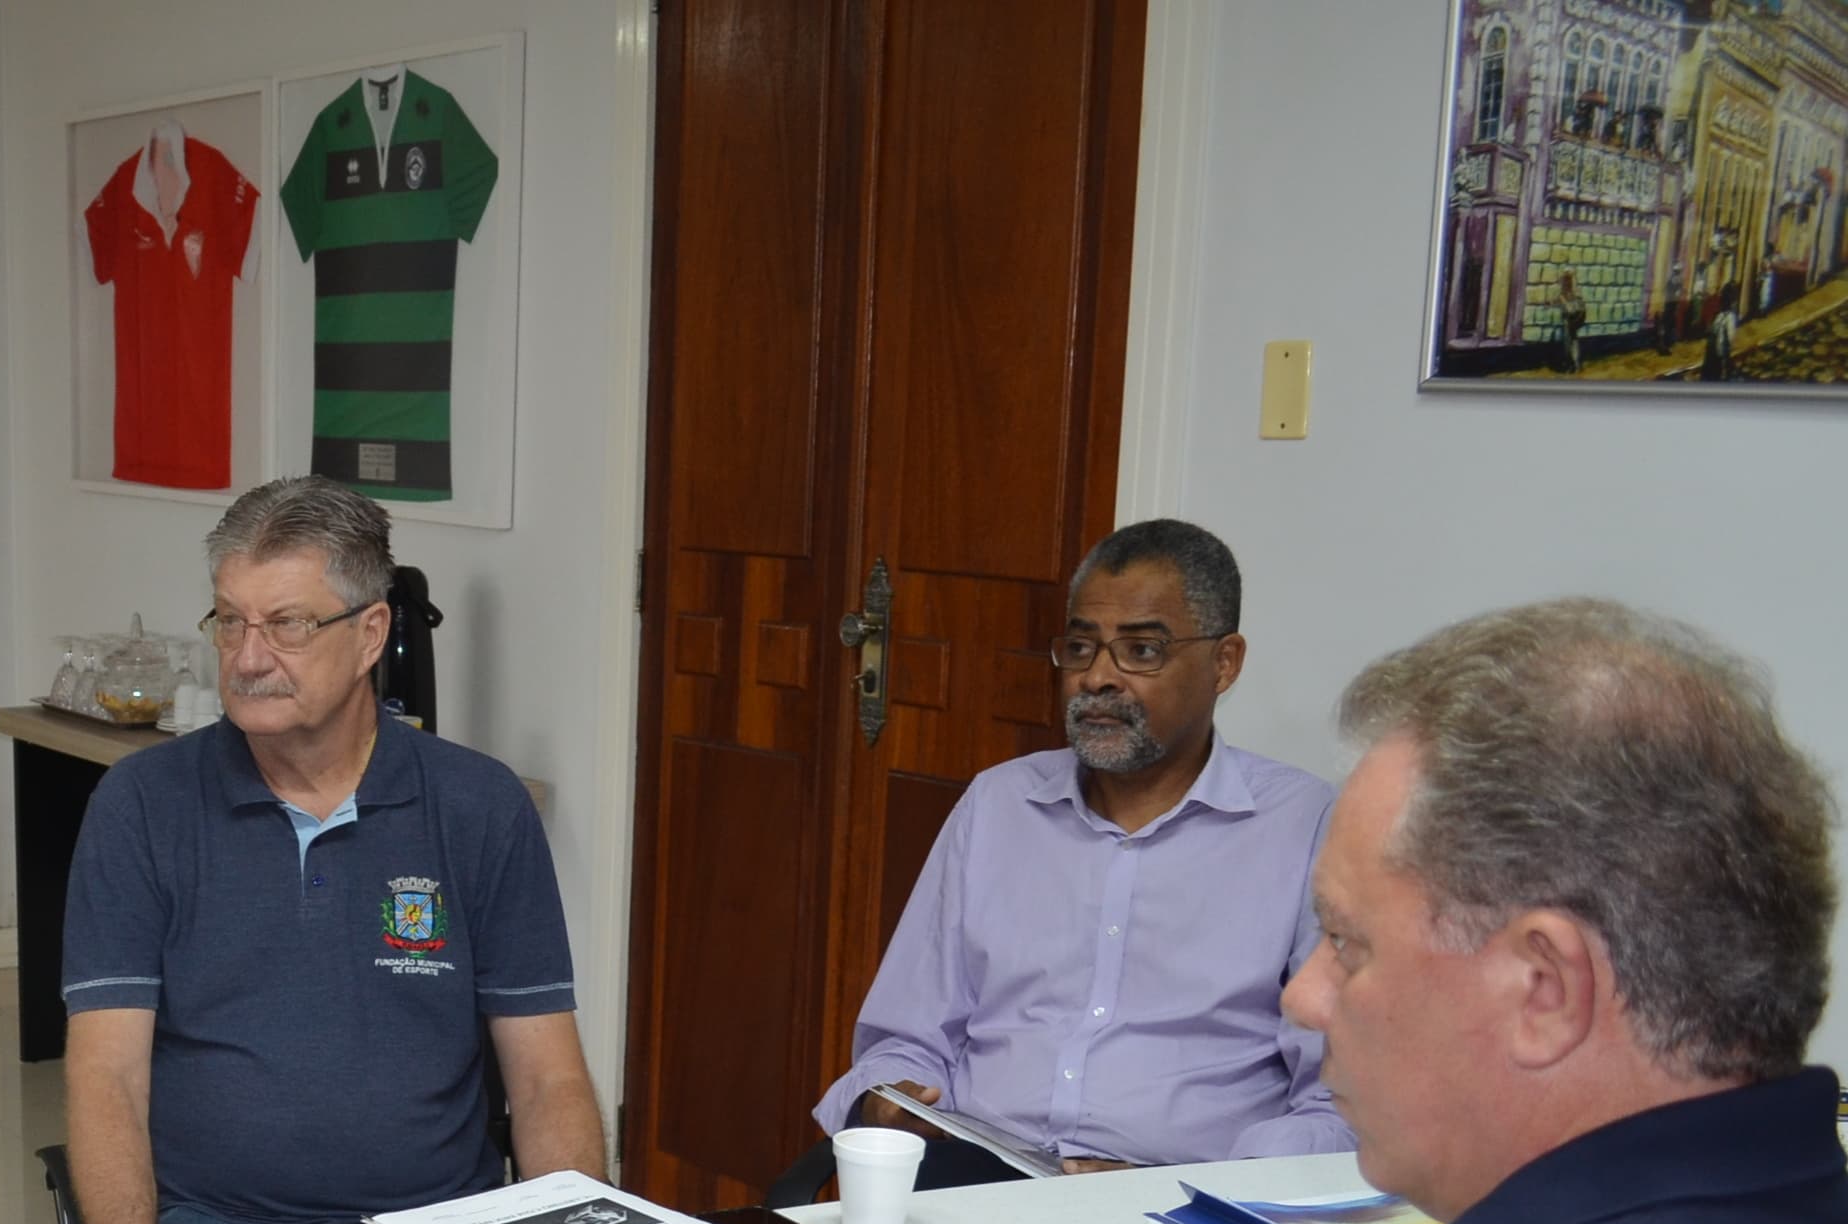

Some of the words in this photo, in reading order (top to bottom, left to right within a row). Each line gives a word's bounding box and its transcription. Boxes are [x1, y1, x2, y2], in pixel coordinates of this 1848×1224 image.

[374, 957, 416, 967] FUNDAÇÃO
[417, 959, 455, 970] MUNICIPAL
[392, 966, 403, 974] DE
